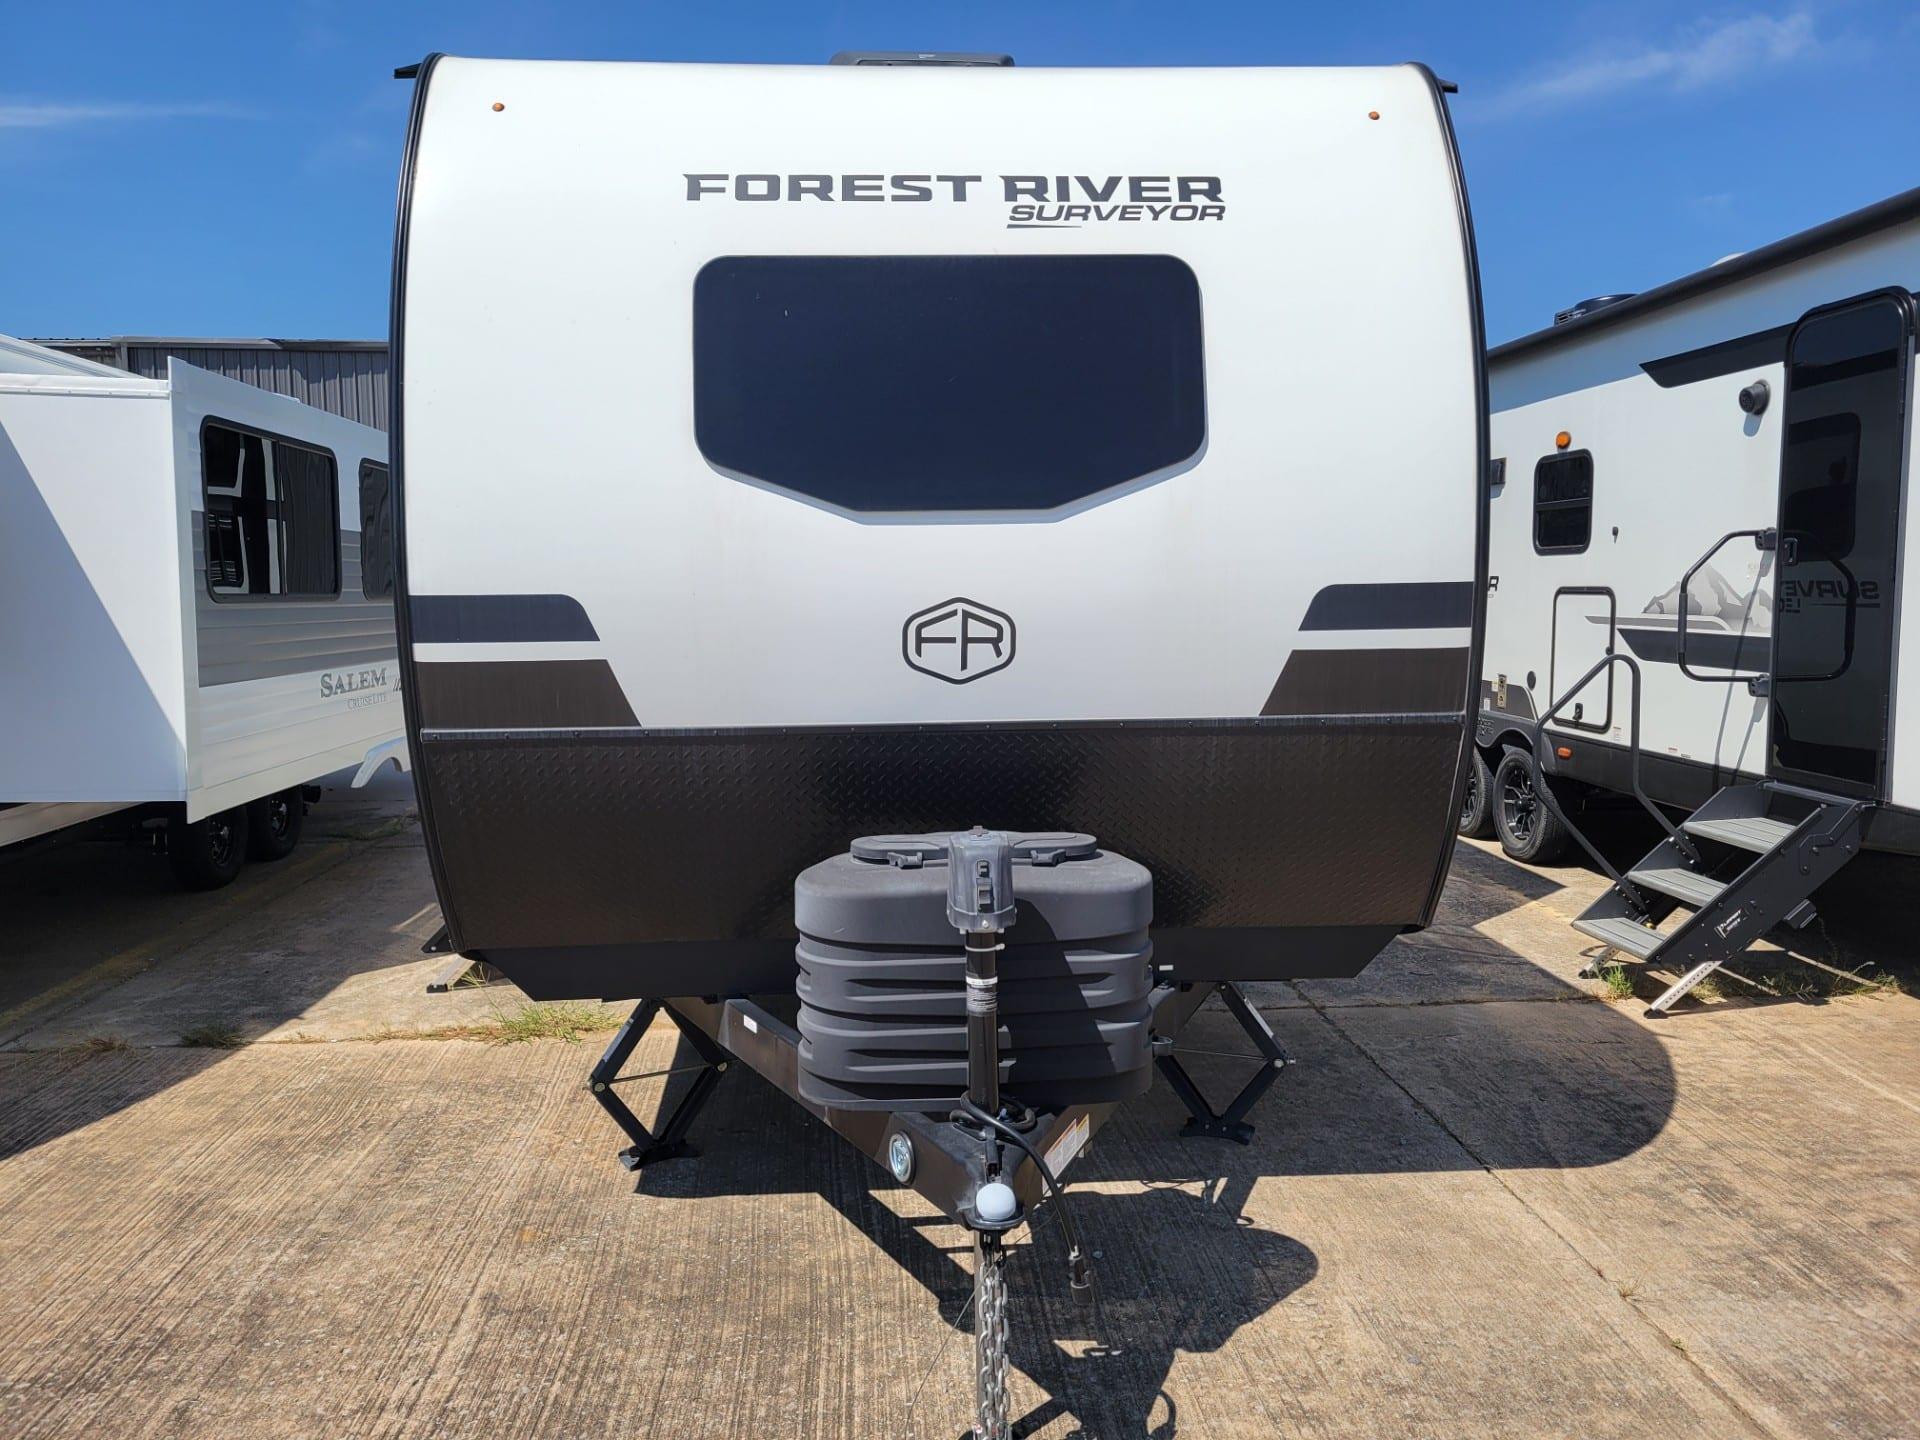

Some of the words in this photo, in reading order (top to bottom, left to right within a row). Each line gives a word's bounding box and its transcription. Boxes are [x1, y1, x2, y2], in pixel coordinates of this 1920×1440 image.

[683, 174, 981, 202] FOREST
[999, 176, 1224, 202] RIVER
[1008, 205, 1226, 221] SURVEYOR
[914, 608, 1004, 672] FR
[320, 667, 387, 698] SALEM
